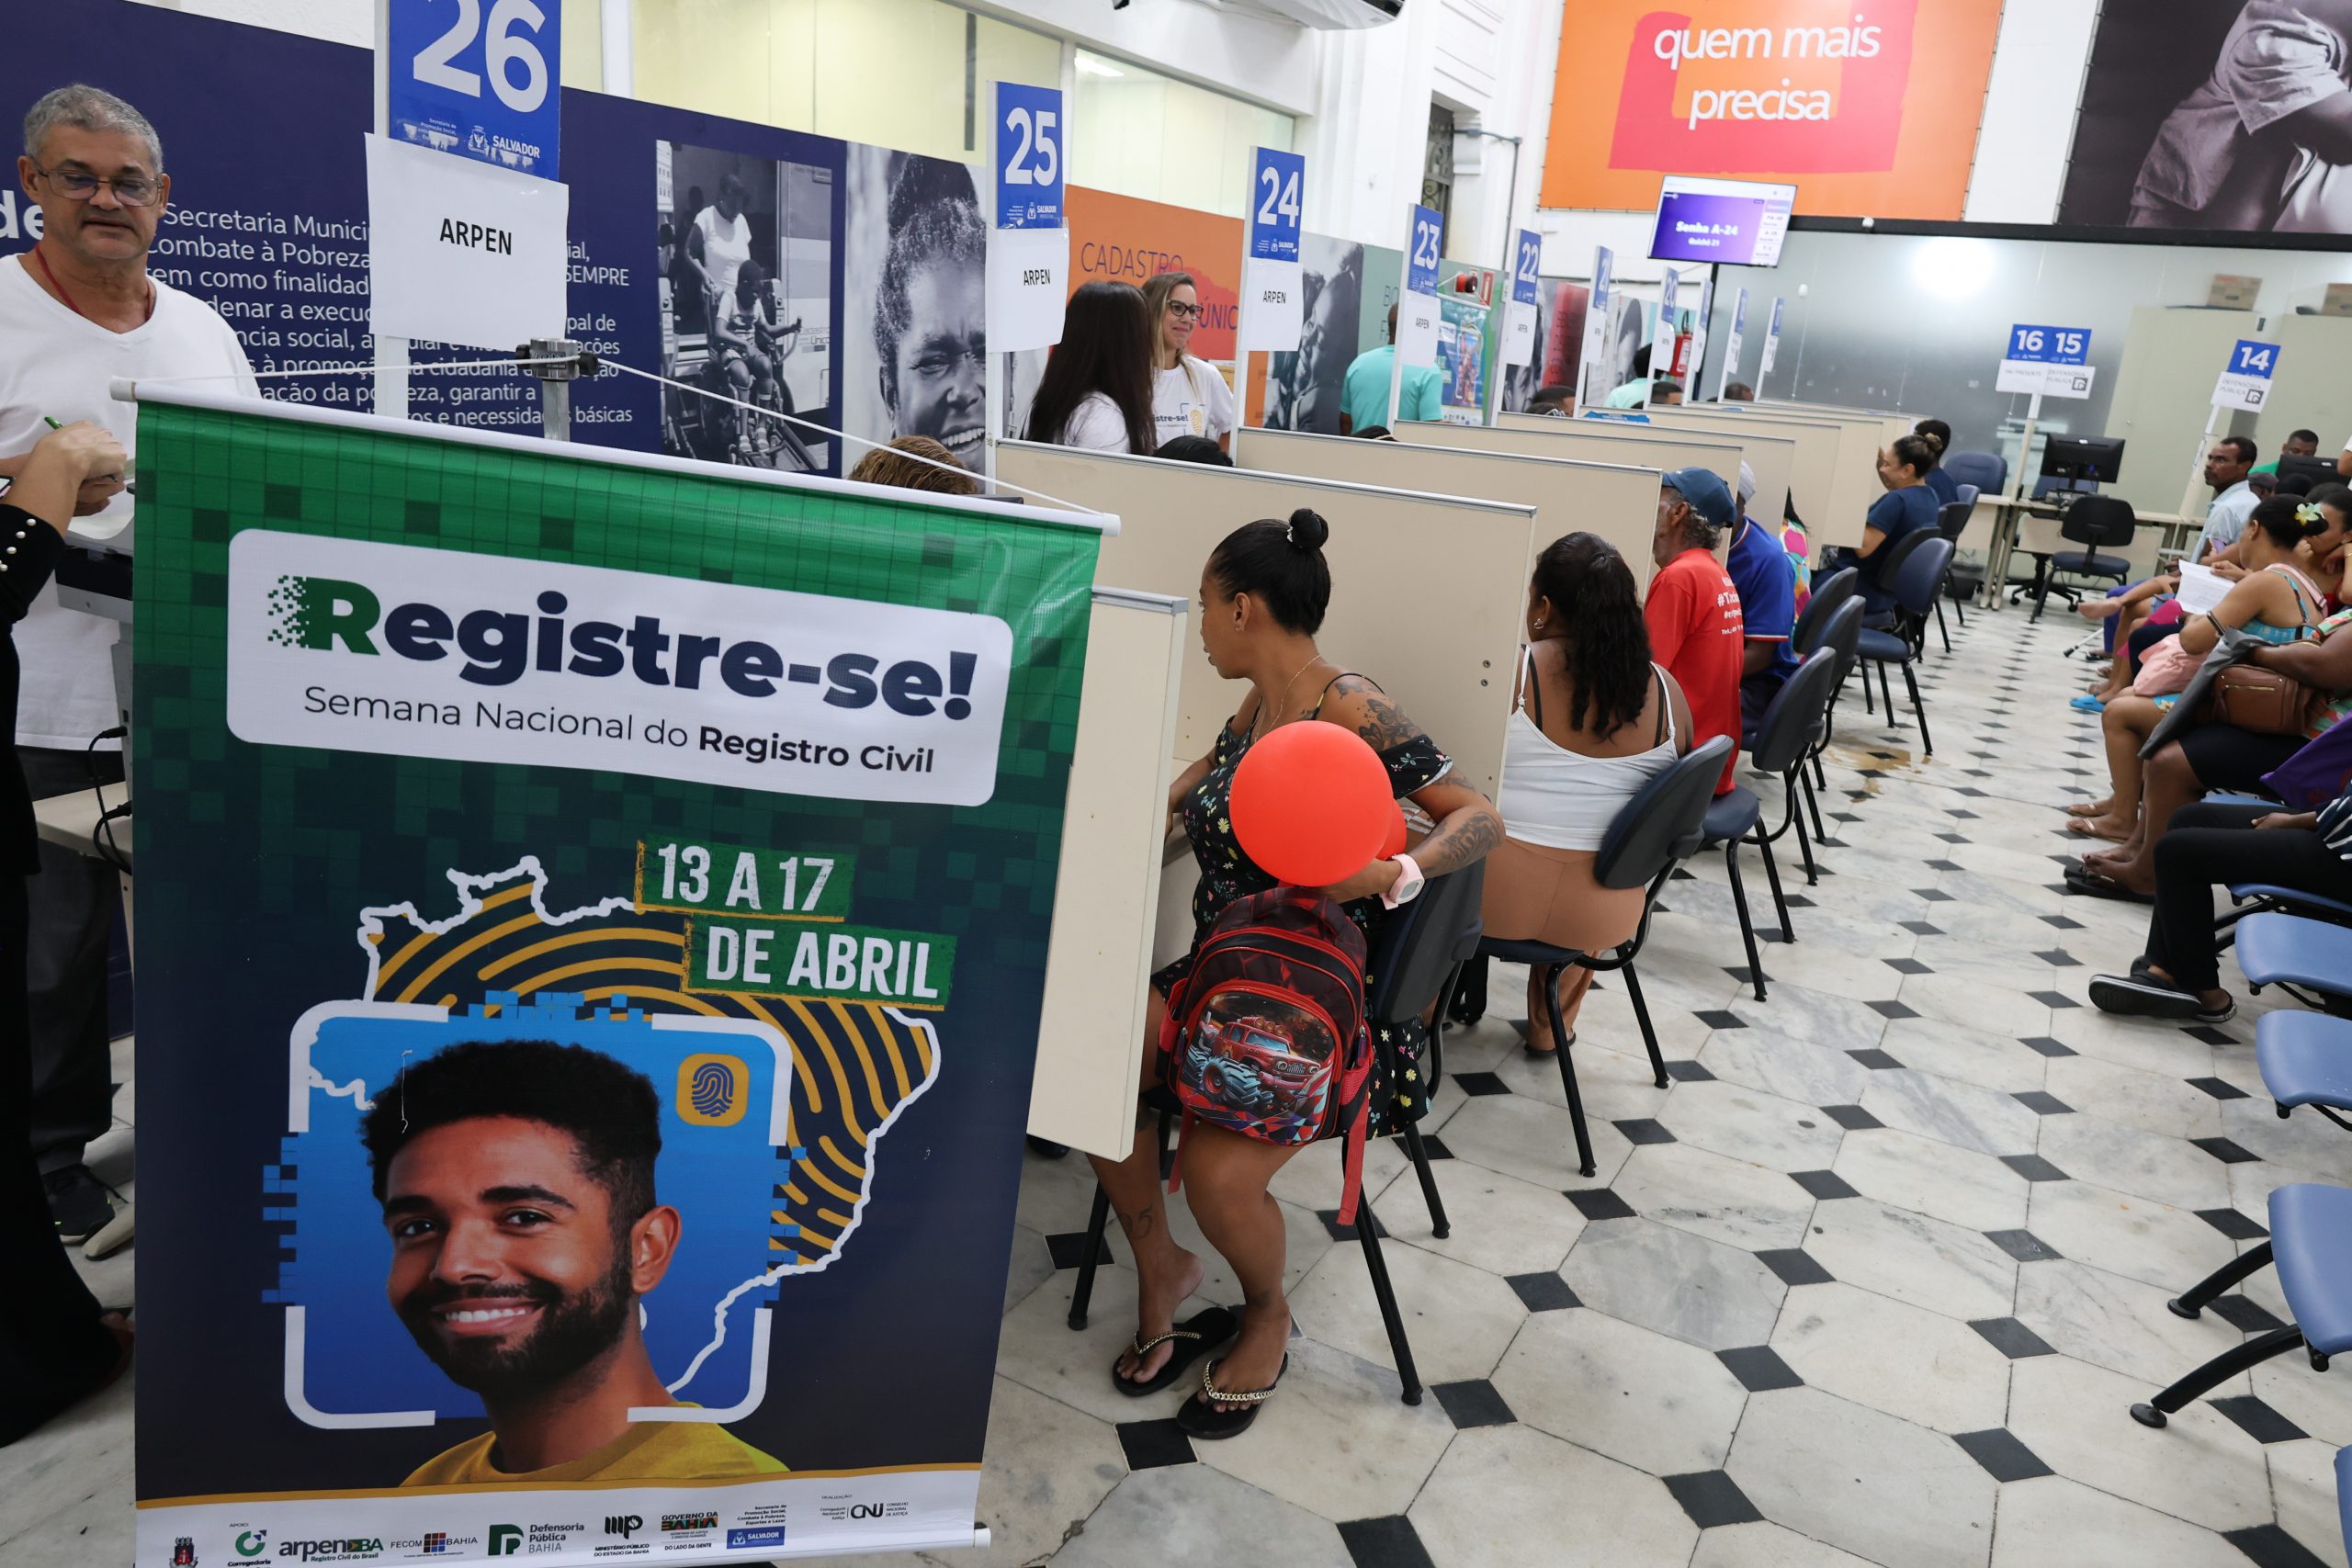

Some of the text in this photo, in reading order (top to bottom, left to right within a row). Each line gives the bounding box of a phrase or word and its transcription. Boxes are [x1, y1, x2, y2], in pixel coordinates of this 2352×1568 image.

[1654, 14, 1882, 71] quem mais
[413, 0, 548, 113] 26
[1689, 77, 1831, 130] precisa
[492, 135, 540, 158] SALVADOR
[1005, 107, 1057, 186] 25
[1257, 166, 1300, 228] 24
[163, 202, 369, 241] Secretaria Munici
[1676, 220, 1738, 236] Senha A-24
[148, 233, 254, 261] ombate
[261, 240, 276, 262] à
[440, 218, 512, 255] ARPEN
[1414, 220, 1440, 271] 23
[1080, 243, 1183, 278] CADASTRO
[1518, 242, 1539, 284] 22
[199, 270, 267, 290] como
[1023, 269, 1050, 286] ARPEN
[1263, 290, 1286, 304] ARPEN
[280, 304, 294, 320] a
[596, 313, 616, 331] de
[288, 326, 356, 352] social,
[2017, 330, 2044, 352] 16
[2055, 333, 2083, 355] 15
[263, 354, 276, 373] à
[429, 356, 519, 377] cidadania
[2240, 346, 2270, 371] 14
[323, 382, 350, 402] da
[449, 383, 521, 405] garantir
[526, 388, 536, 400] a
[575, 405, 633, 423] básicas
[268, 575, 978, 720] Registre-se!
[304, 686, 933, 773] Semana Nacional do Registro Civil
[658, 843, 834, 911] 13 A 17
[707, 926, 938, 998] DE ABRIL
[662, 1512, 704, 1521] GOVERNO
[851, 1503, 884, 1518] CNJ
[529, 1523, 584, 1533] Defensoria
[661, 1517, 718, 1531] BAHIA
[748, 1531, 779, 1540] SALVADOR
[390, 1537, 478, 1549] FECOM BAHIA
[528, 1542, 562, 1553] BAHIA
[529, 1533, 566, 1543] Pública
[227, 1559, 271, 1567] Corregedoria
